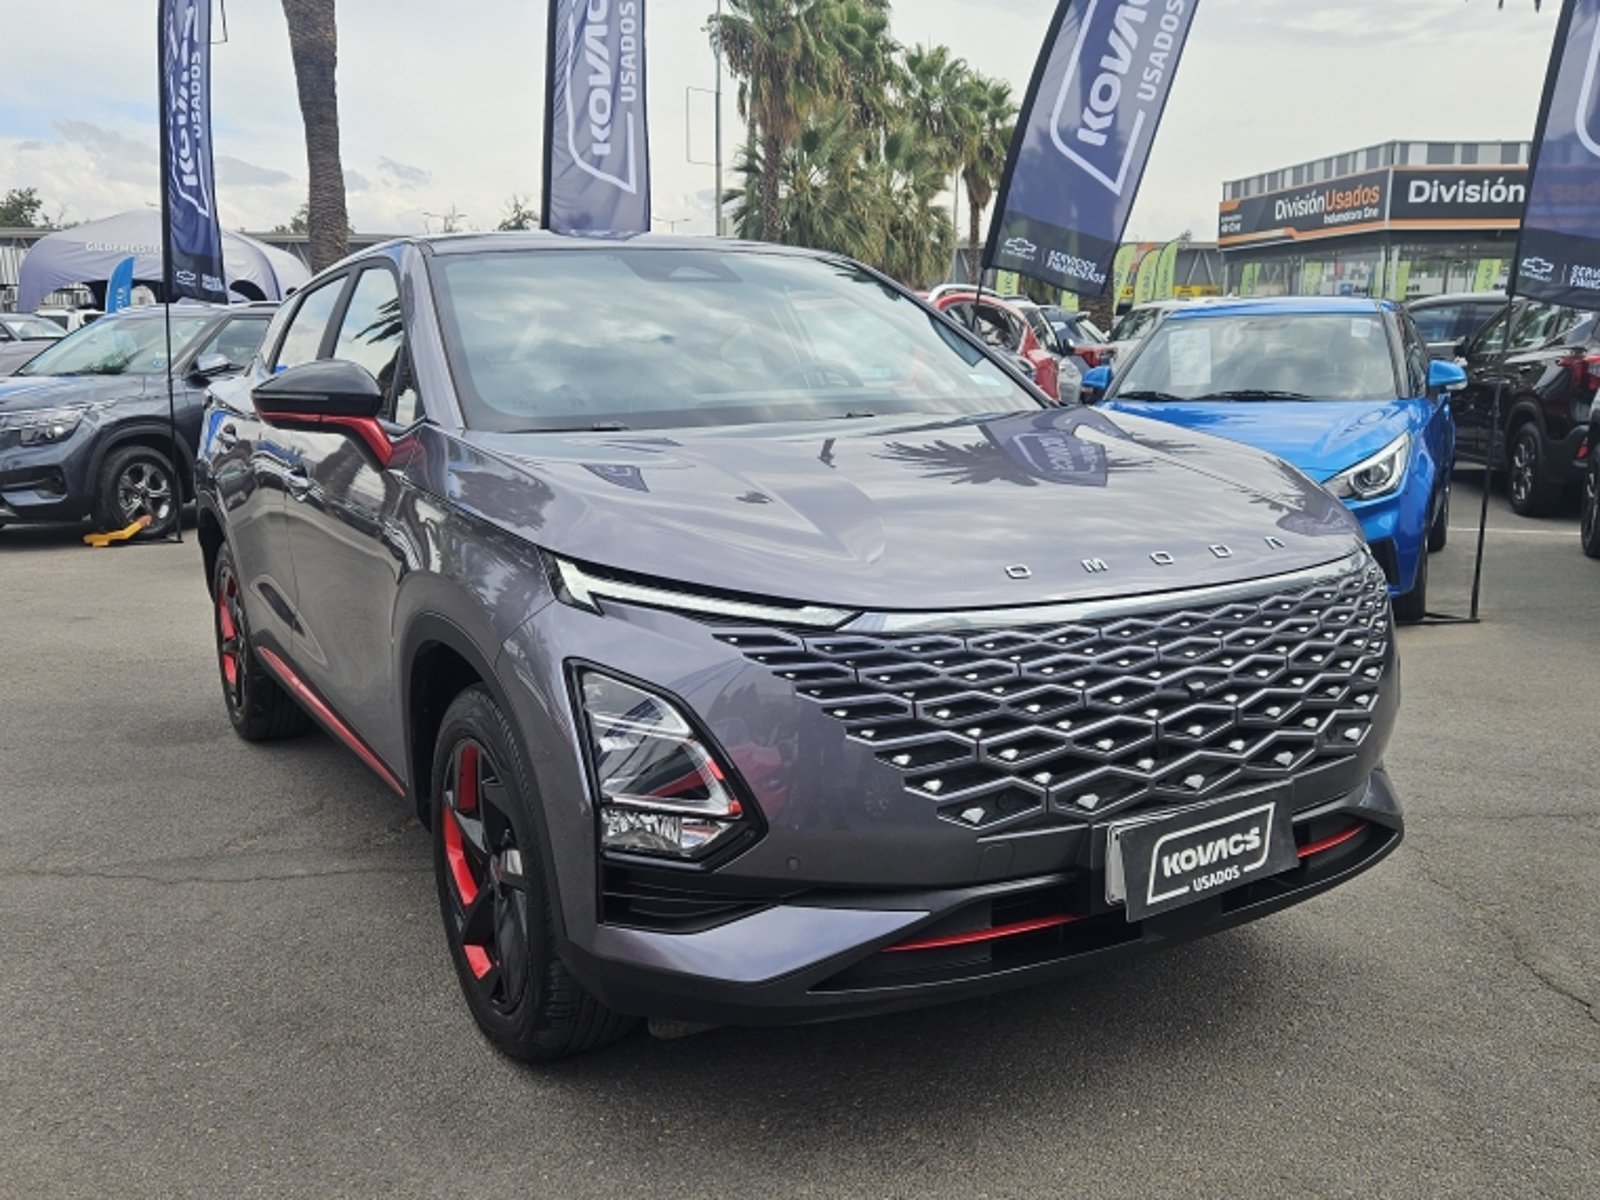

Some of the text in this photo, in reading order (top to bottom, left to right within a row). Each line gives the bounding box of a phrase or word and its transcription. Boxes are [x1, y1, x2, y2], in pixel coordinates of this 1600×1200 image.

[619, 3, 636, 102] USADOS
[1136, 0, 1186, 103] USADOS
[1407, 176, 1526, 203] División
[1161, 826, 1262, 878] KOVACS
[1192, 864, 1242, 892] USADOS
